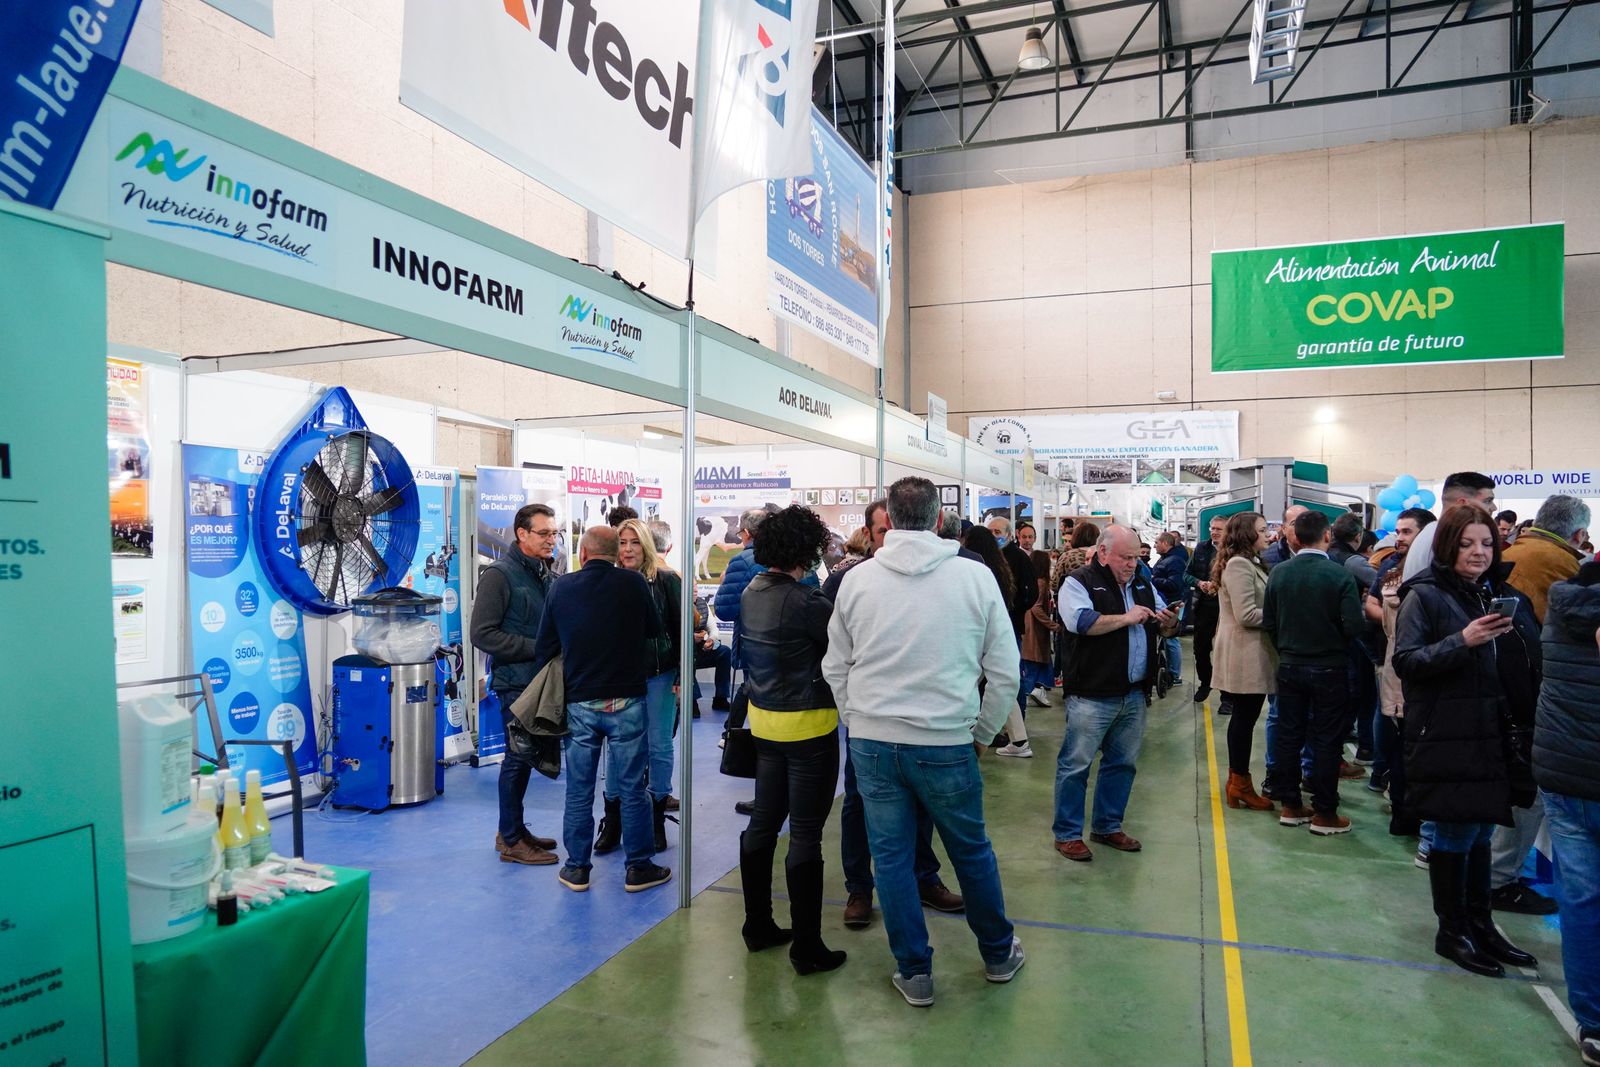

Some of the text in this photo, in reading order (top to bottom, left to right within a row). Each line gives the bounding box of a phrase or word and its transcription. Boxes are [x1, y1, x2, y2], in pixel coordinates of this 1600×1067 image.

[0, 0, 116, 200] m-laue.
[206, 164, 328, 232] innofarm
[768, 178, 777, 215] HO
[121, 182, 311, 257] Nutrición y Salud
[830, 200, 839, 268] ROQUE
[788, 228, 825, 268] DOS TORRES
[1265, 240, 1500, 284] Alimentación Animal
[372, 237, 524, 316] INNOFARM
[779, 293, 812, 324] TELEFONO
[1306, 286, 1455, 326] COVAP
[592, 308, 642, 342] innofarm
[561, 326, 636, 361] Nutrición y Salud
[1296, 334, 1465, 360] garantía de futuro
[779, 387, 798, 409] AOR
[1126, 420, 1191, 440] GEA
[1085, 446, 1105, 454] PARA
[1174, 444, 1219, 452] GANADERA
[424, 470, 452, 480] DeLaval
[571, 466, 635, 485] DELTA-LAMBDA
[1489, 473, 1591, 485] WORLD WIDE
[276, 473, 297, 538] DeLaval
[481, 492, 525, 502] Paralelo P500
[490, 503, 517, 511] DeLaval
[190, 523, 233, 534] ¿POR QUÉ
[839, 512, 866, 525] gen
[0, 538, 45, 555] TOS.
[191, 536, 238, 544] ES MEJOR?
[0, 564, 23, 580] ES
[235, 647, 257, 659] 3500
[0, 786, 21, 800] io
[48, 981, 63, 991] de
[11, 1034, 23, 1046] el
[25, 1020, 64, 1041] riesgo
